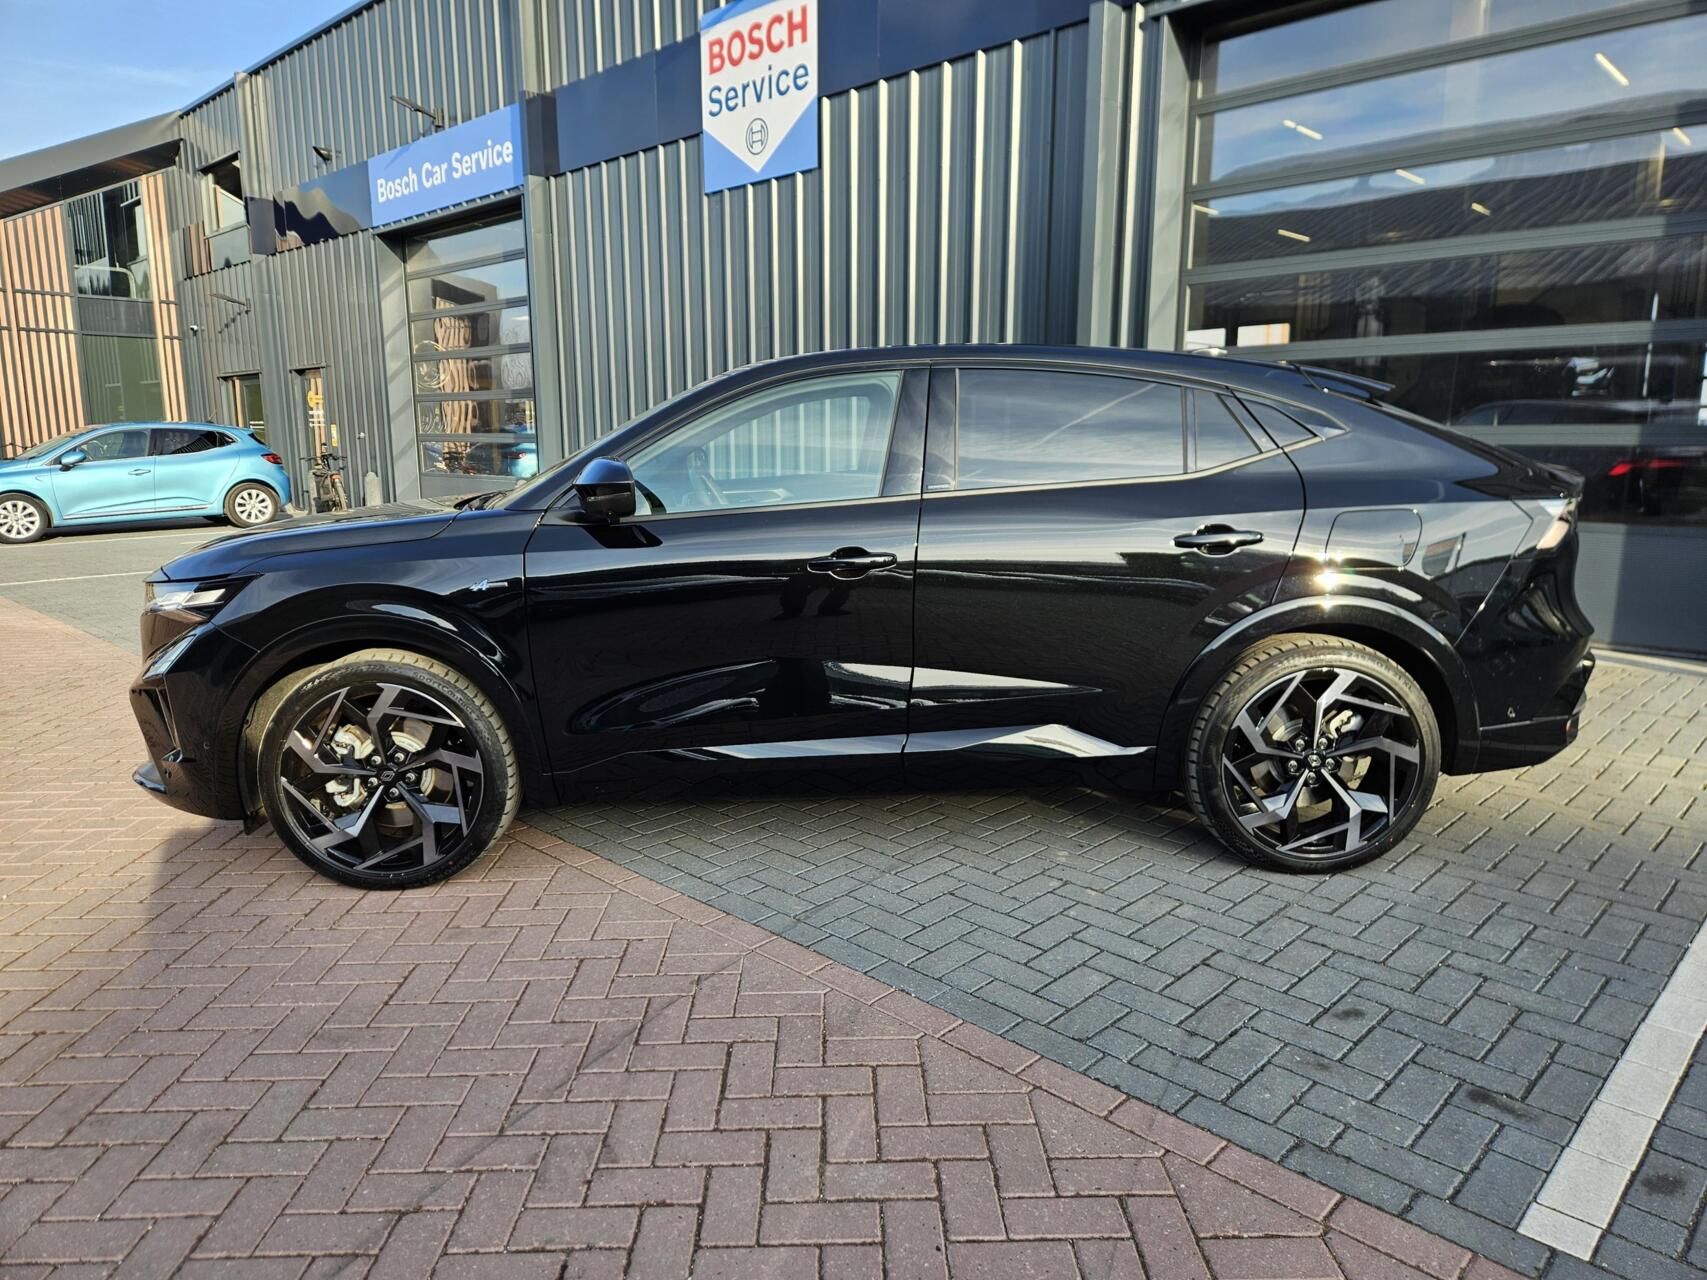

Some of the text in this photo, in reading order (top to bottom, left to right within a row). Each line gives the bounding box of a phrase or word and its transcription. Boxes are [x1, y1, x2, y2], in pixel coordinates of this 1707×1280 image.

[708, 4, 808, 75] BOSCH
[708, 63, 809, 117] Service
[377, 138, 513, 203] Bosch Car Service
